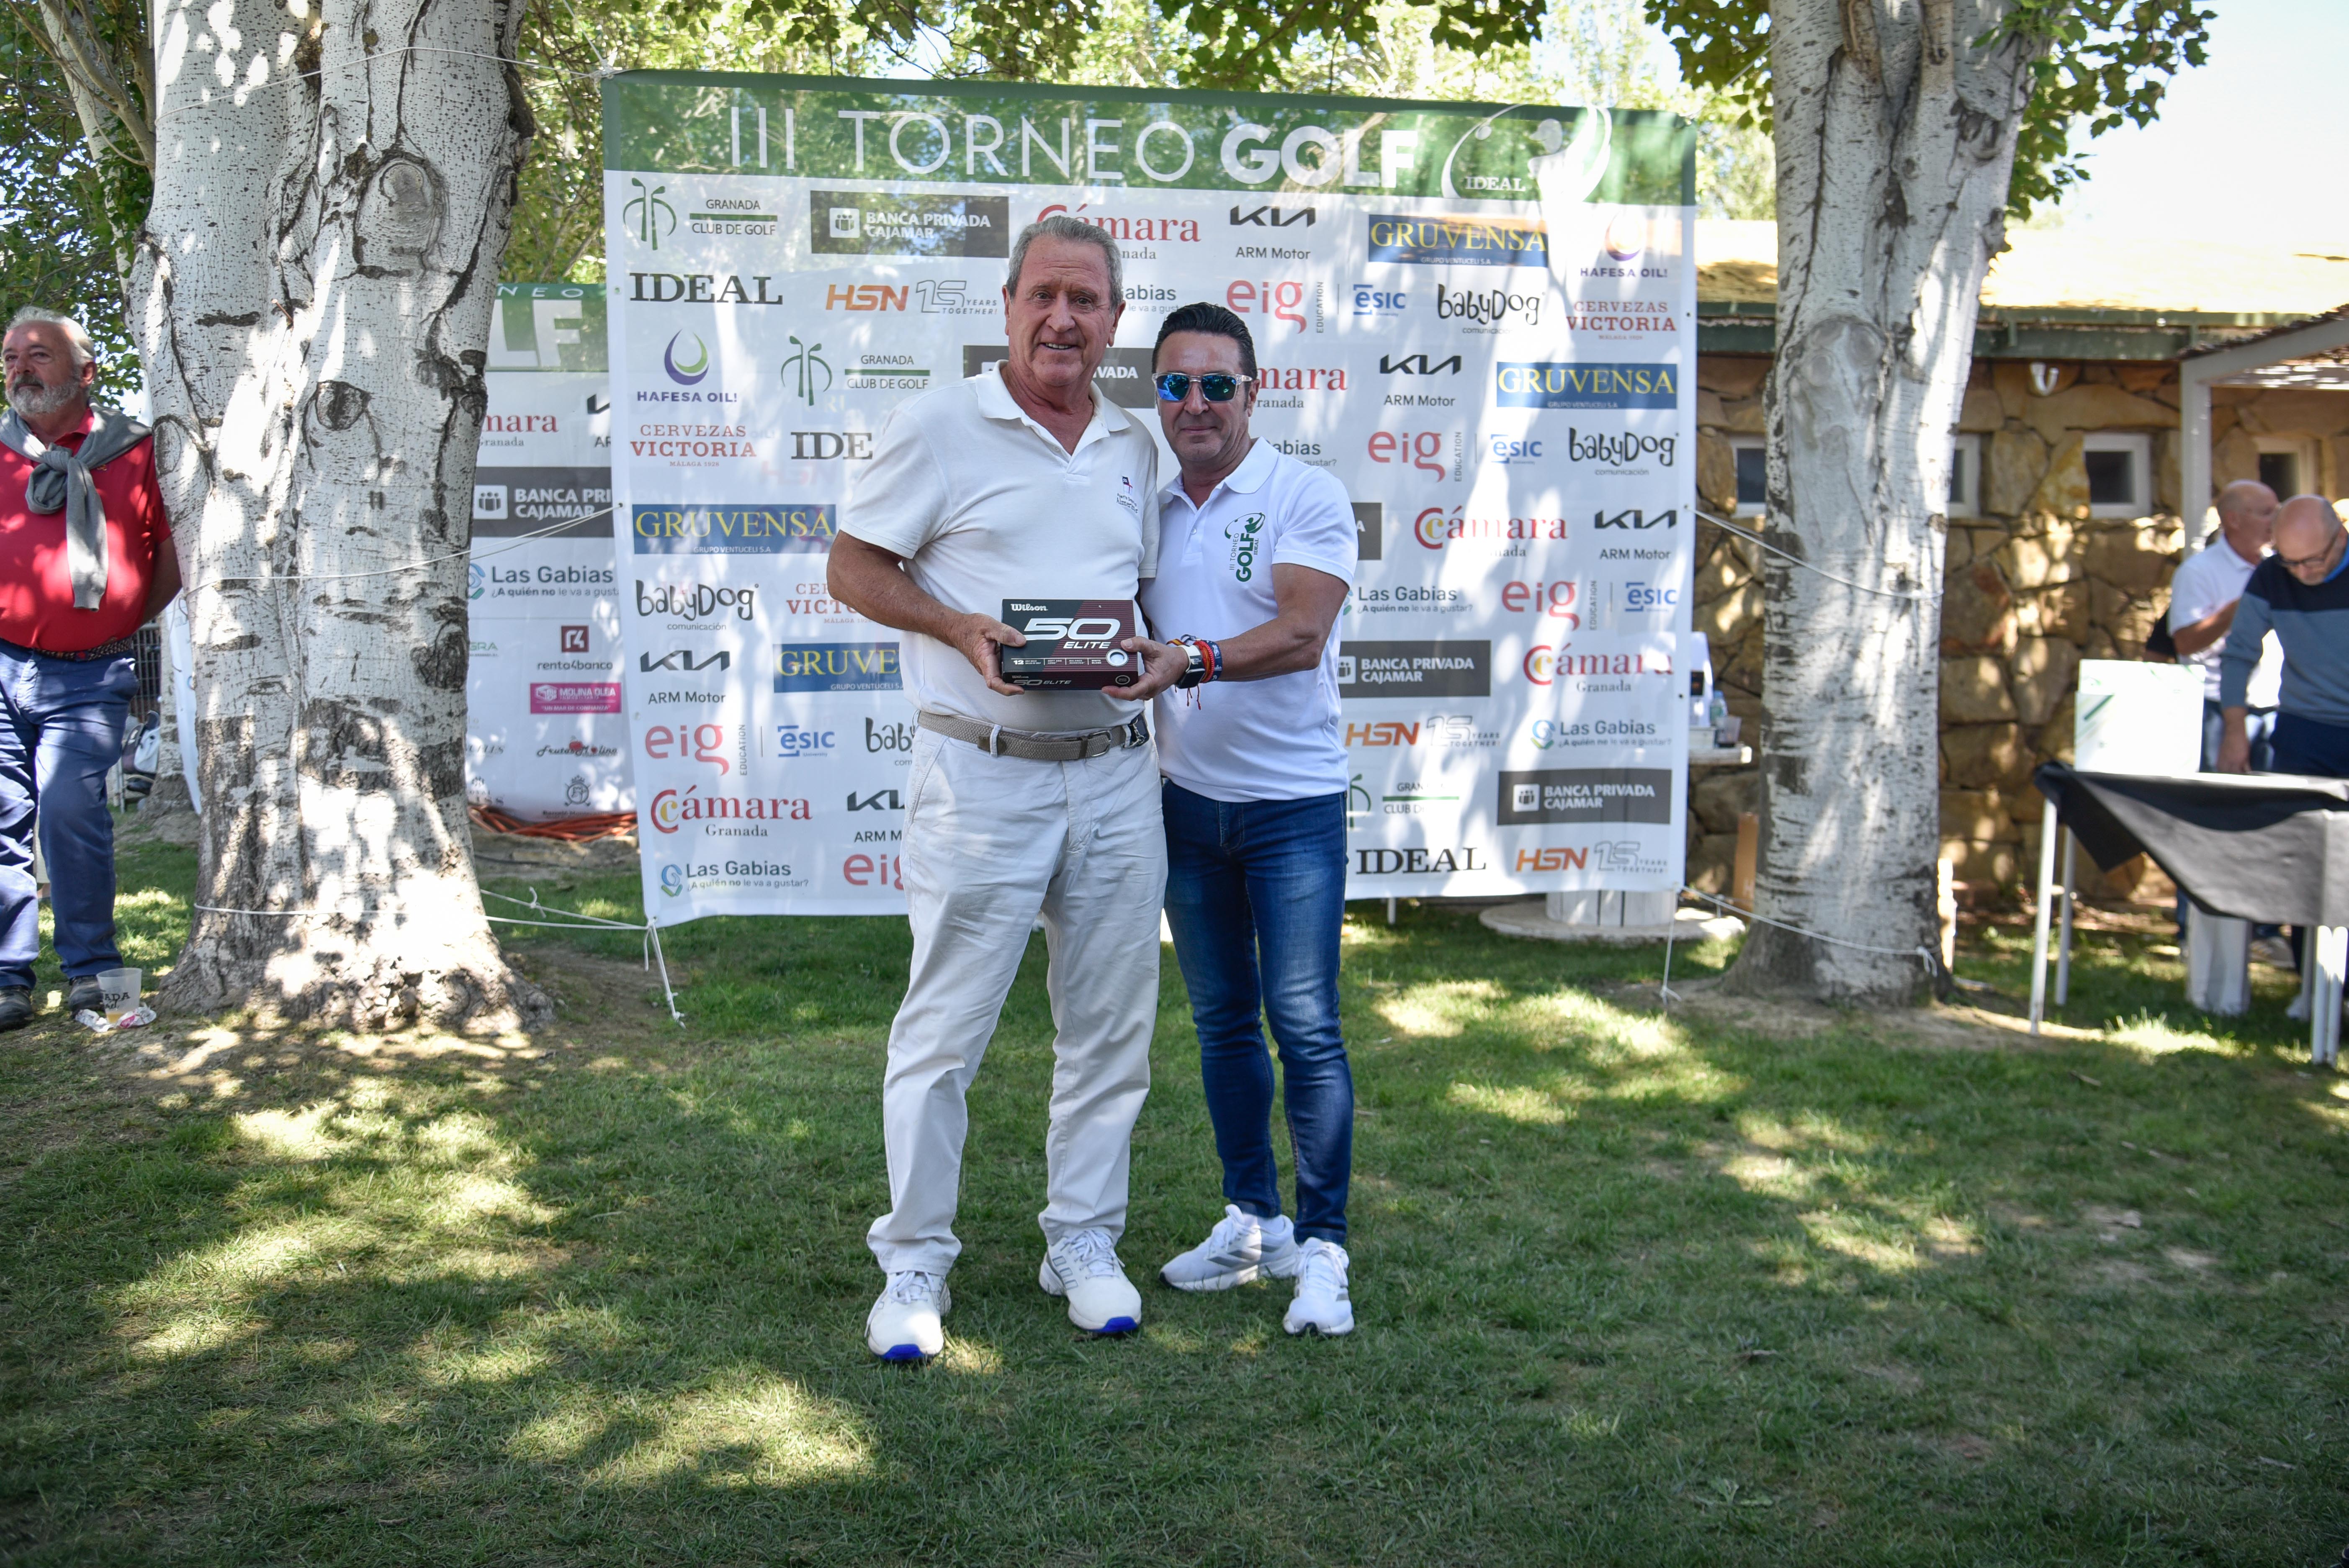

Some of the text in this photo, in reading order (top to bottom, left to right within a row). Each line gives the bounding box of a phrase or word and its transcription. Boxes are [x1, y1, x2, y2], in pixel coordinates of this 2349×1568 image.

[731, 106, 1418, 188] III TORNEO GOLF
[1465, 176, 1526, 193] IDEAL
[706, 199, 761, 210] GRANADA
[866, 211, 991, 228] BANCA PRIVADA
[692, 223, 776, 235] CLUB DE GOLF
[866, 226, 934, 239] CAJAMAR
[1371, 222, 1546, 251] GRUVENSA
[1235, 247, 1311, 260] ARM Motor
[1580, 267, 1668, 278] HAFESA OIL!
[629, 272, 783, 305] IDEAL
[826, 285, 909, 311] HSN
[1227, 280, 1307, 334] eig
[1574, 301, 1668, 313] CERVEZAS
[1566, 316, 1677, 332] VICTORIA
[860, 355, 914, 365] GRANADA
[847, 378, 928, 389] CLUB DE GOLF
[1497, 367, 1675, 394] GRUVENSA
[637, 392, 737, 403] HAFESA OIL!
[1384, 395, 1455, 406] ARM Motor
[640, 424, 746, 437] CERVEZAS
[630, 441, 757, 457] VICTORIA
[1368, 431, 1446, 483] eig
[515, 489, 579, 503] BANCA
[515, 505, 594, 521] CAJAMAR
[635, 512, 833, 538] GRUVENSA
[1230, 533, 1239, 561] TORNEO
[1236, 533, 1254, 582] GOLF
[1599, 549, 1671, 560] ARM Motor
[492, 566, 613, 583] Las Gabias
[507, 588, 539, 597] quién
[559, 587, 567, 596] le
[1358, 586, 1457, 601] Las Gabias
[1372, 604, 1394, 614] quién
[1441, 605, 1473, 614] gustar?
[1501, 581, 1580, 631] eig
[1024, 617, 1121, 640] 50
[537, 661, 613, 671] renta4banco
[1361, 658, 1474, 670] BANCA PRIVADA
[1361, 671, 1423, 683] CAJAMAR
[560, 687, 592, 696] MOLINA
[1577, 680, 1632, 693] Granada
[648, 691, 726, 704] ARM Motor
[1345, 722, 1420, 746] HSN
[1560, 720, 1656, 735] Las Gabias
[645, 723, 729, 776] eig
[1544, 785, 1655, 798] BANCA PRIVADA
[651, 784, 813, 834] Cámara
[1384, 804, 1411, 814] CLUB
[1544, 798, 1603, 809] CAJAMAR
[706, 824, 768, 837] Granada
[854, 830, 886, 843] ARM
[1356, 847, 1487, 875] IDEAL
[1515, 847, 1588, 872] HSN
[686, 861, 792, 878] Las Gabias
[699, 879, 727, 890] quién
[774, 878, 809, 889] gustar?
